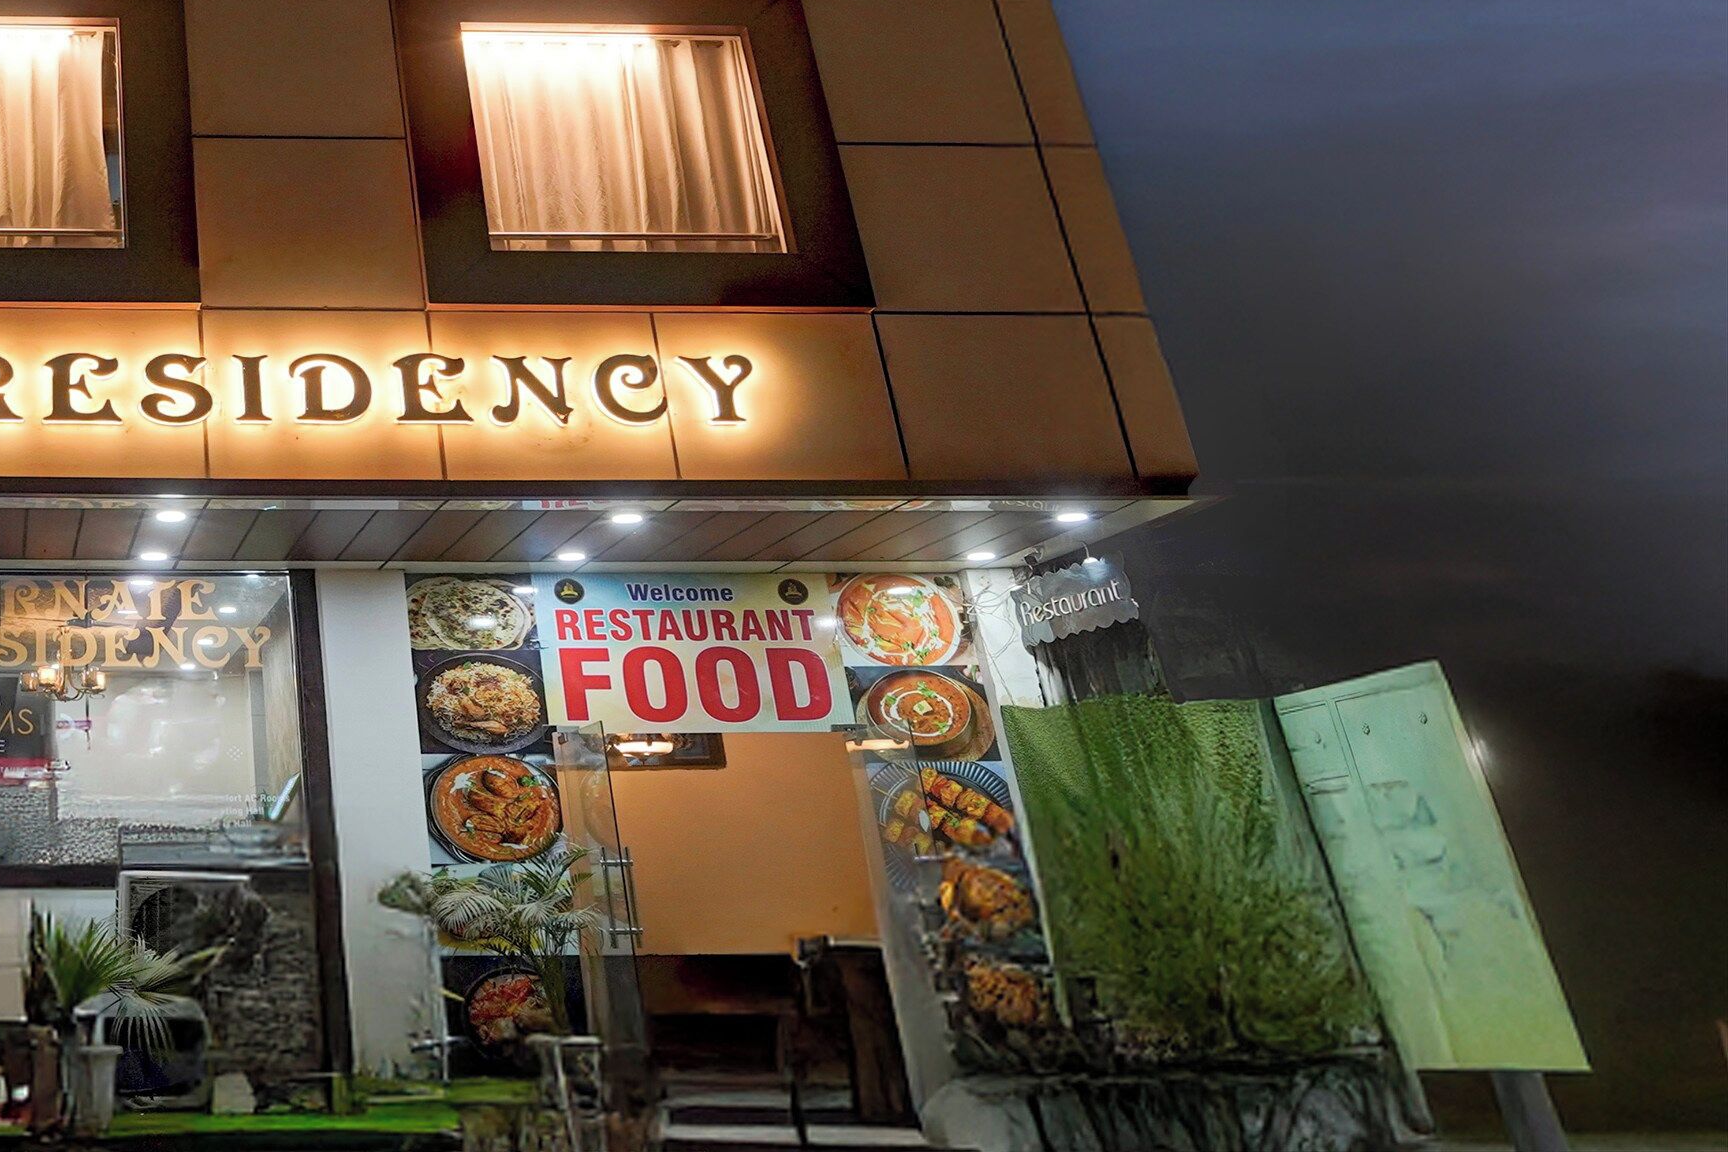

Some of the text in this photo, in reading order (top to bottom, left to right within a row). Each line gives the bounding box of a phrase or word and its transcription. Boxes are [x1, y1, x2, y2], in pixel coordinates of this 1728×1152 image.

[625, 582, 734, 602] Welcome
[1019, 579, 1121, 626] Restaurant
[553, 608, 815, 642] RESTAURANT
[557, 645, 833, 724] FOOD
